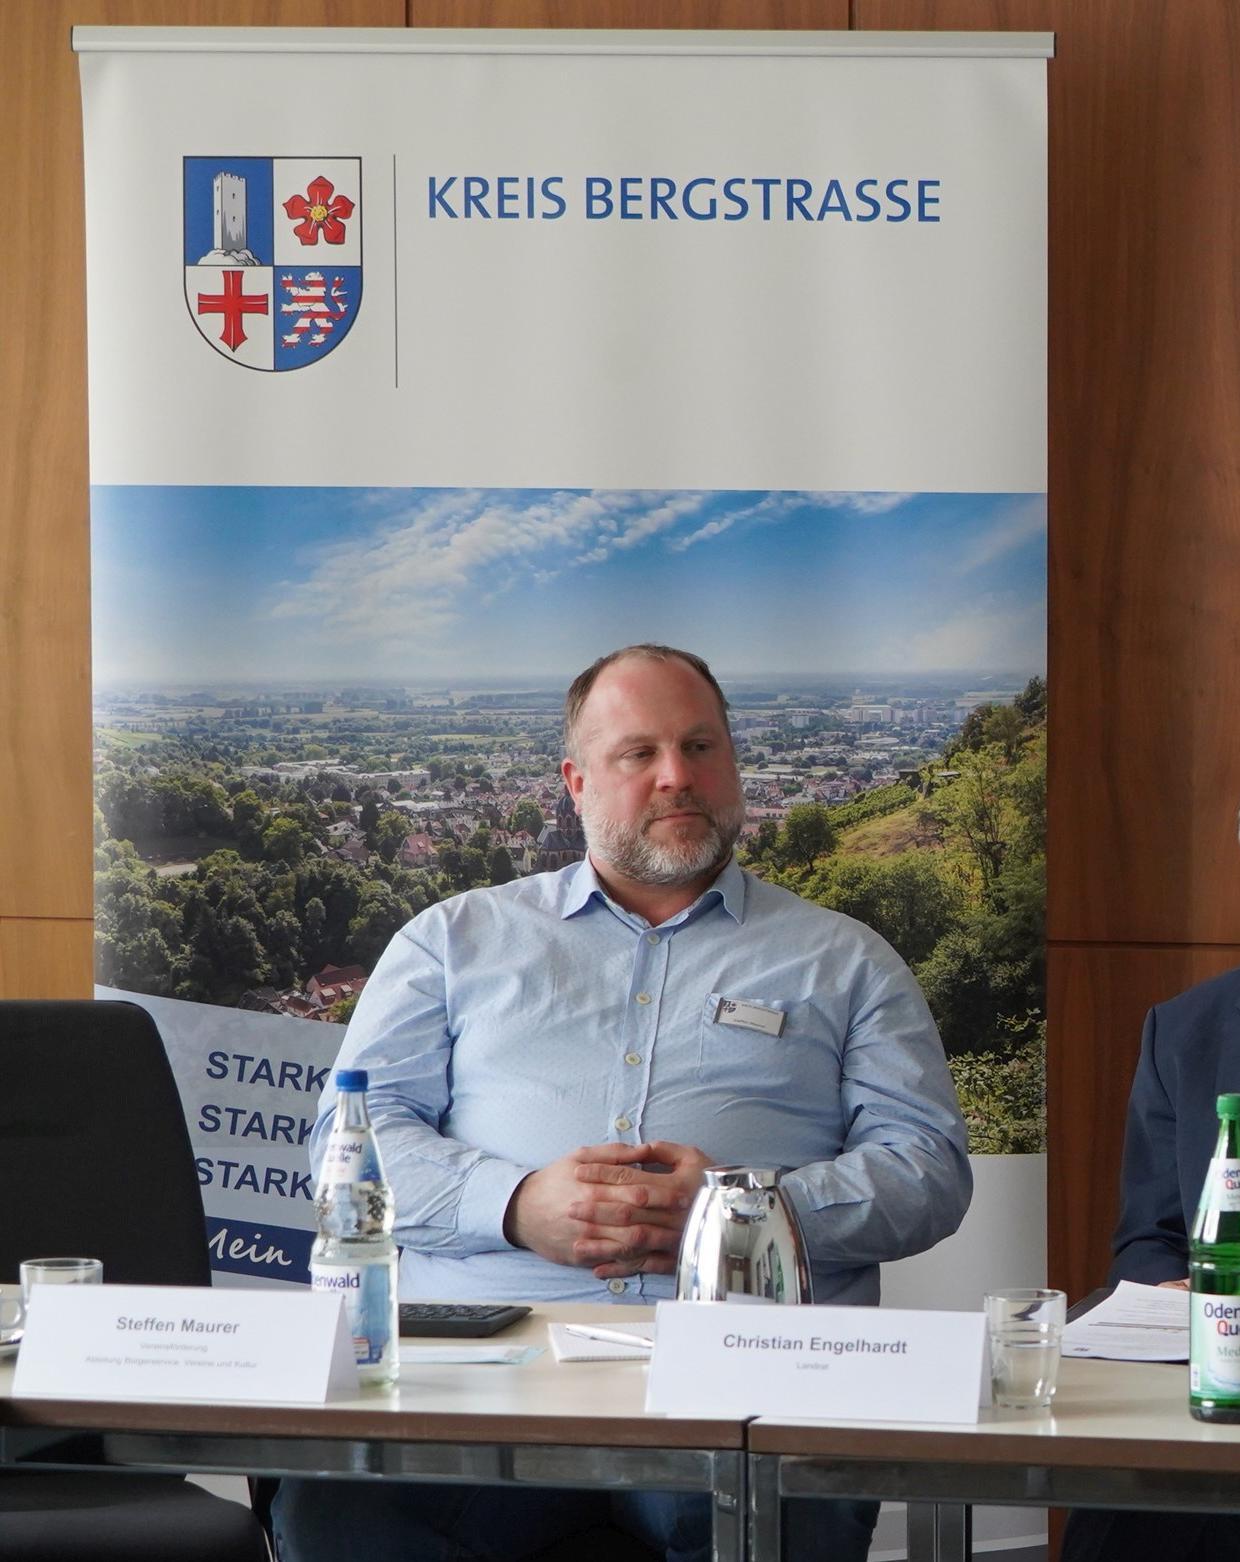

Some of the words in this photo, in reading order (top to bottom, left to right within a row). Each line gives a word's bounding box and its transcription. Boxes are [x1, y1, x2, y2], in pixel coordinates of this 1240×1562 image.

[427, 176, 567, 220] KREIS
[585, 176, 942, 223] BERGSTRASSE
[194, 1157, 316, 1201] STARK
[116, 1316, 175, 1332] Steffen
[181, 1318, 240, 1334] Maurer
[723, 1334, 804, 1350] Christian
[810, 1336, 908, 1355] Engelhardt
